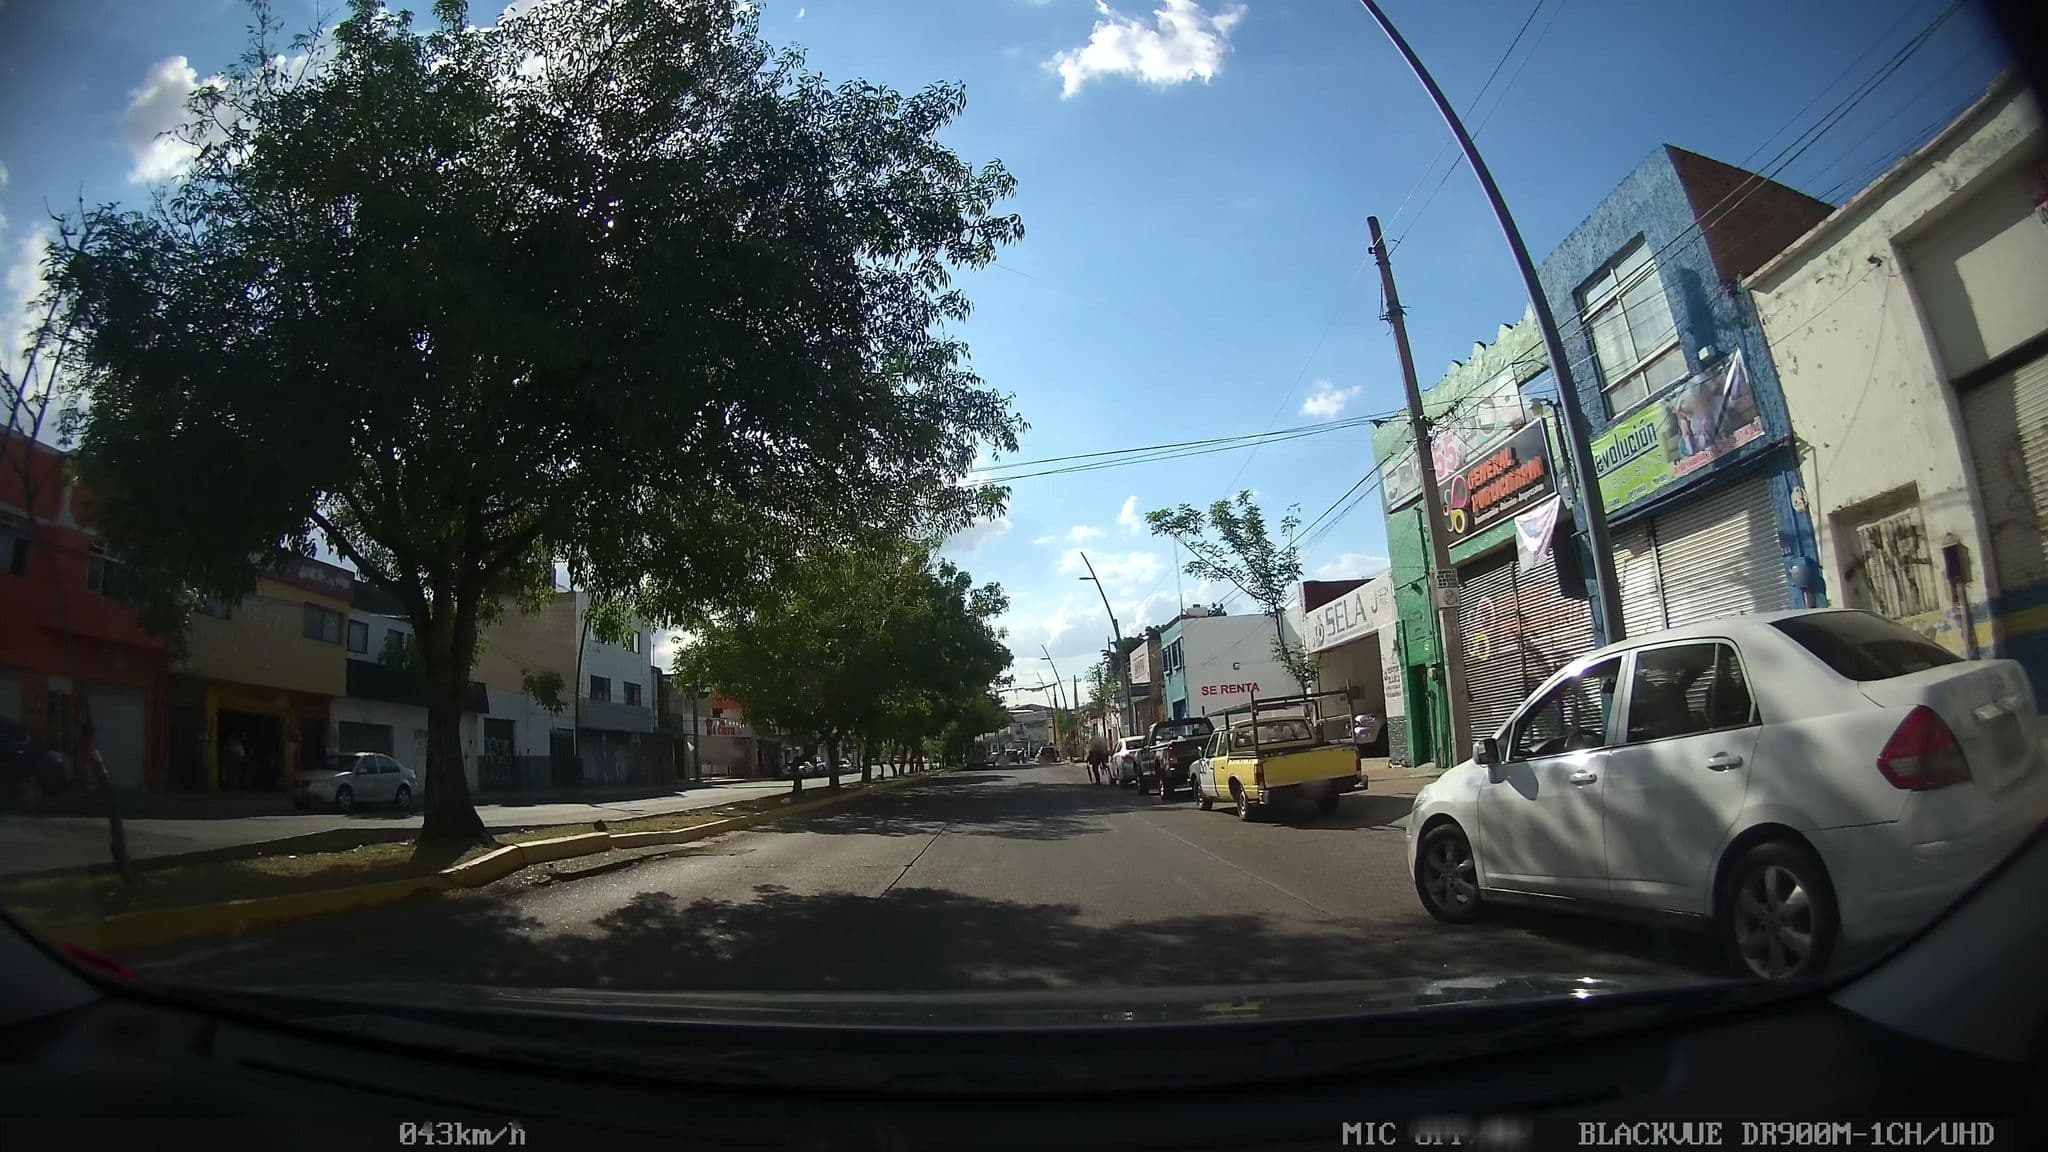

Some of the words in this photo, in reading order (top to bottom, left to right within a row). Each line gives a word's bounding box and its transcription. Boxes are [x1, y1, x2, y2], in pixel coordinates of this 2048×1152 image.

[1325, 593, 1367, 637] SELA
[1201, 686, 1217, 696] SE
[1220, 682, 1260, 694] RENTA
